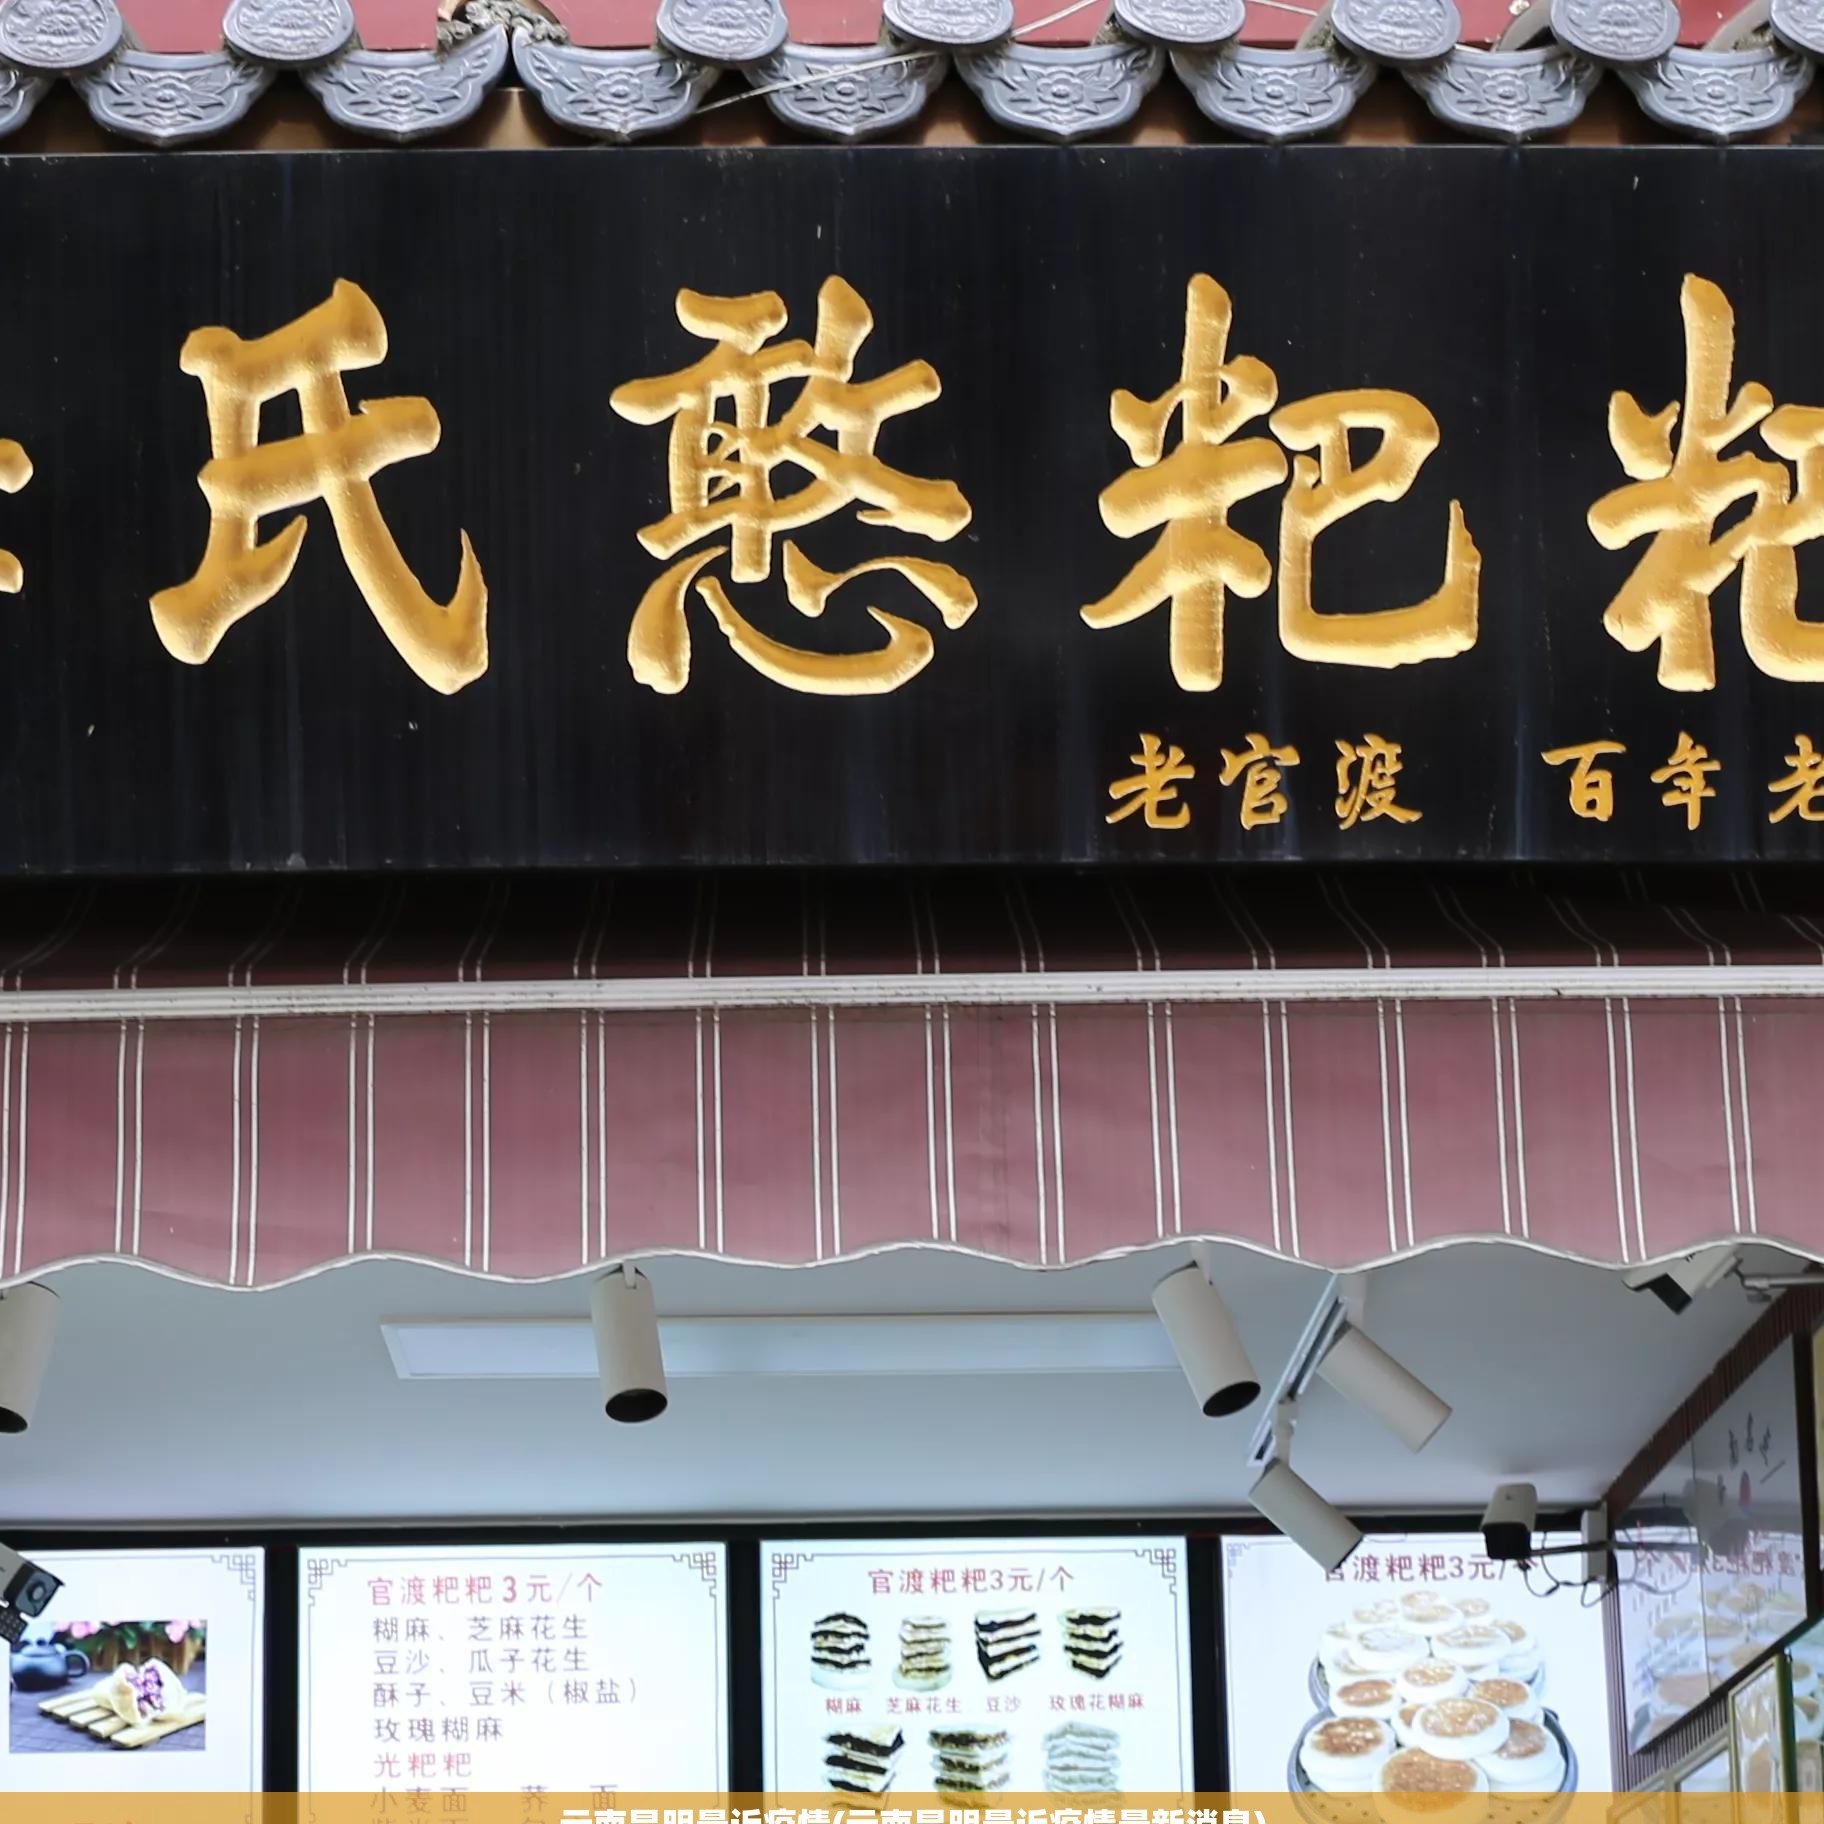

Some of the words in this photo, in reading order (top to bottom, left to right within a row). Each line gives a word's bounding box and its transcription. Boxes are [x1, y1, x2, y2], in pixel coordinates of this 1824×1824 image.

[1106, 734, 1423, 829] 老官渡
[368, 1572, 603, 1605] 官渡粑粑3元/个
[868, 1565, 1075, 1595] 官渡粑粑3元/个
[373, 1614, 589, 1644] 糊麻、芝麻花生
[373, 1647, 589, 1676] 豆沙、瓜子花生
[825, 1696, 863, 1714] 糊麻
[886, 1696, 962, 1714] 芝麻花生
[985, 1695, 1021, 1712] 豆沙
[374, 1715, 504, 1743] 玫瑰糊麻
[374, 1751, 473, 1779] 光粑粑
